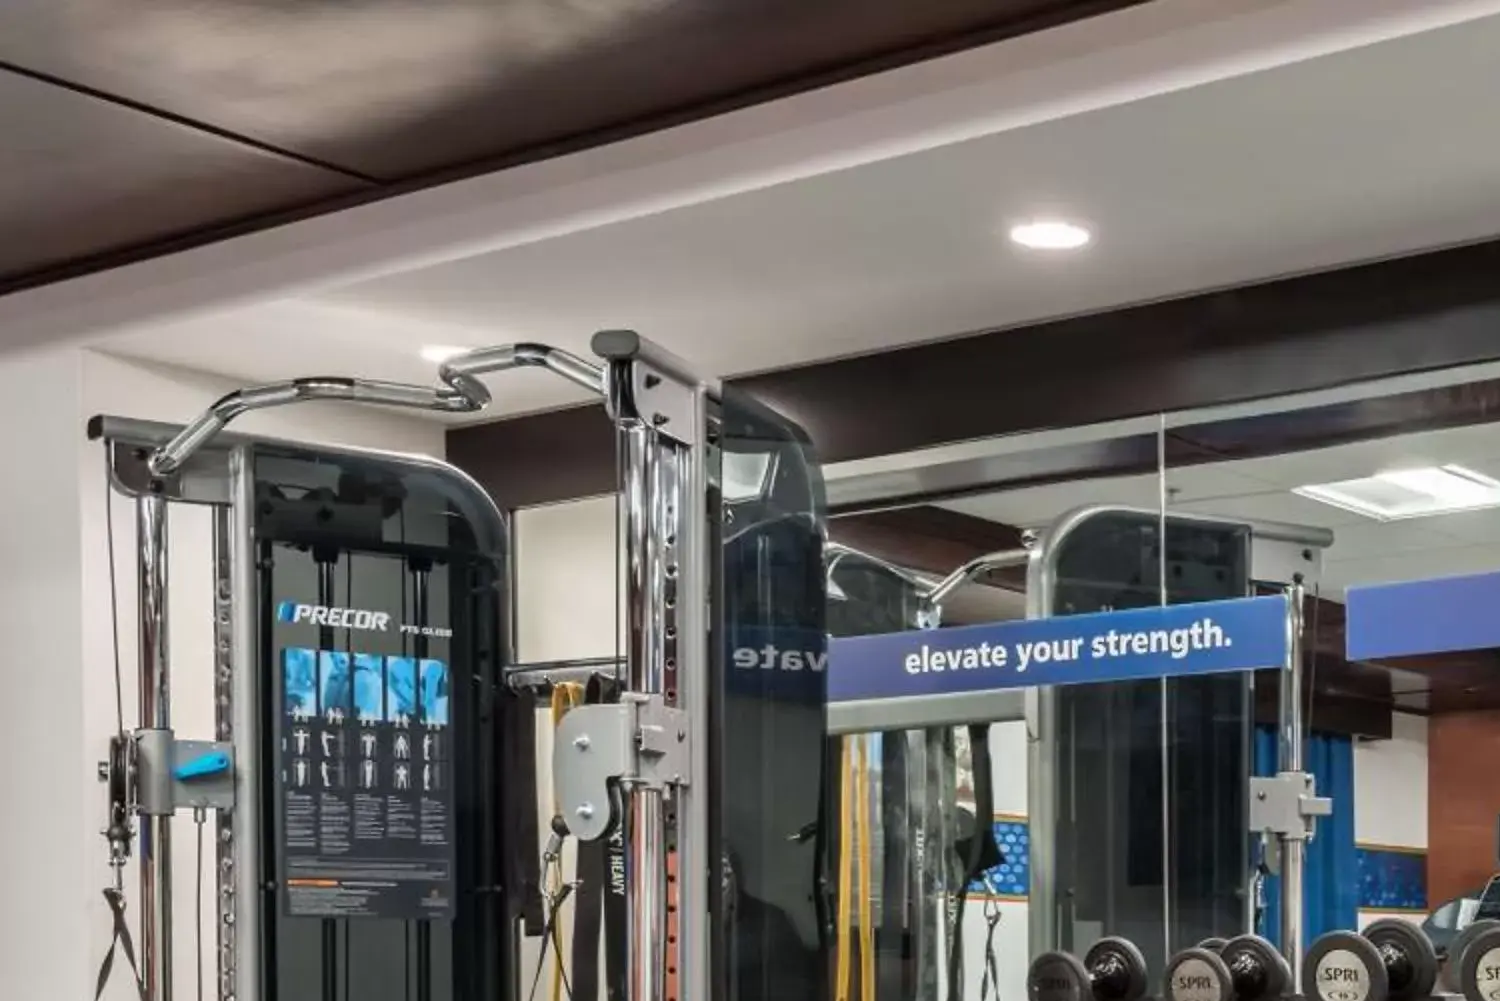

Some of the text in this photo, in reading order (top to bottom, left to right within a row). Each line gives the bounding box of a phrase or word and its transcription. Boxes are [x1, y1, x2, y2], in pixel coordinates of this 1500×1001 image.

[292, 602, 391, 632] PRECOR
[904, 617, 1233, 675] elevate your strength.
[611, 855, 625, 896] HEAVY
[1179, 976, 1211, 989] SPRI
[1324, 967, 1359, 983] SPRI
